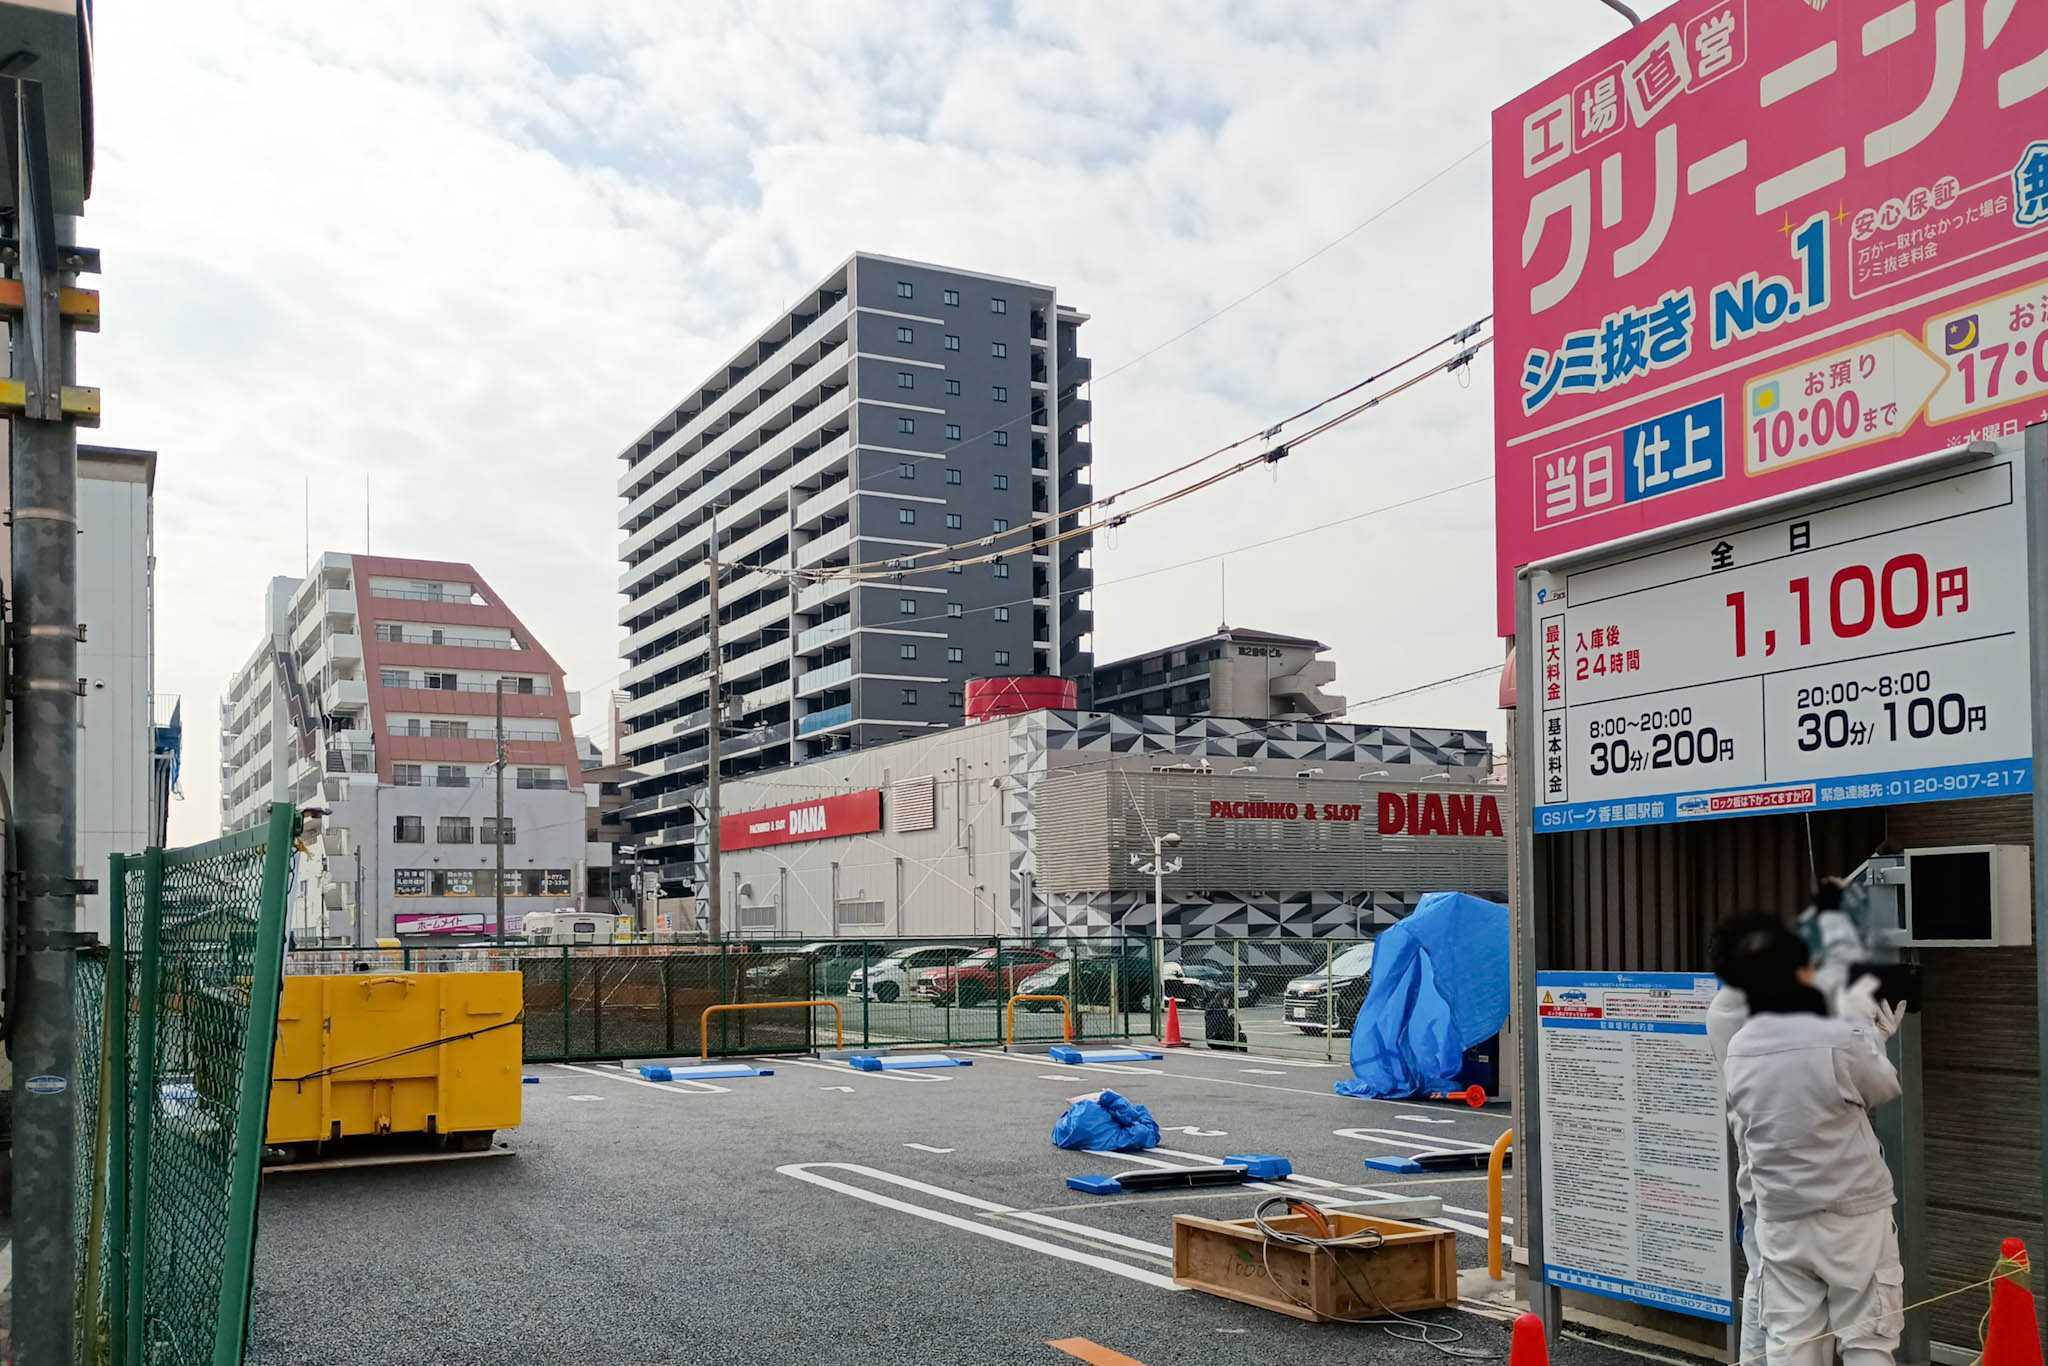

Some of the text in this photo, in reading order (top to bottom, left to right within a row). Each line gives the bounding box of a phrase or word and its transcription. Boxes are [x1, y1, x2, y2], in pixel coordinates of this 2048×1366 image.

[1526, 8, 1738, 170] 工場直営
[1854, 179, 1958, 239] 安心保証
[1857, 196, 2008, 265] 万が一取れなかった場合
[1858, 242, 1938, 283] シミ抜き料金
[1523, 215, 1827, 413] シミ抜き No.1
[1803, 353, 1876, 397] お預り
[1725, 552, 1969, 658] 1,100円
[1546, 624, 1561, 702] 最大料金
[1575, 625, 1621, 653] 入庫後
[1576, 649, 1641, 681] 24時間
[1548, 717, 1563, 794] 基本料金
[789, 805, 827, 835] DIANA
[1210, 791, 1504, 837] PACHINKO & SLOT DIANA
